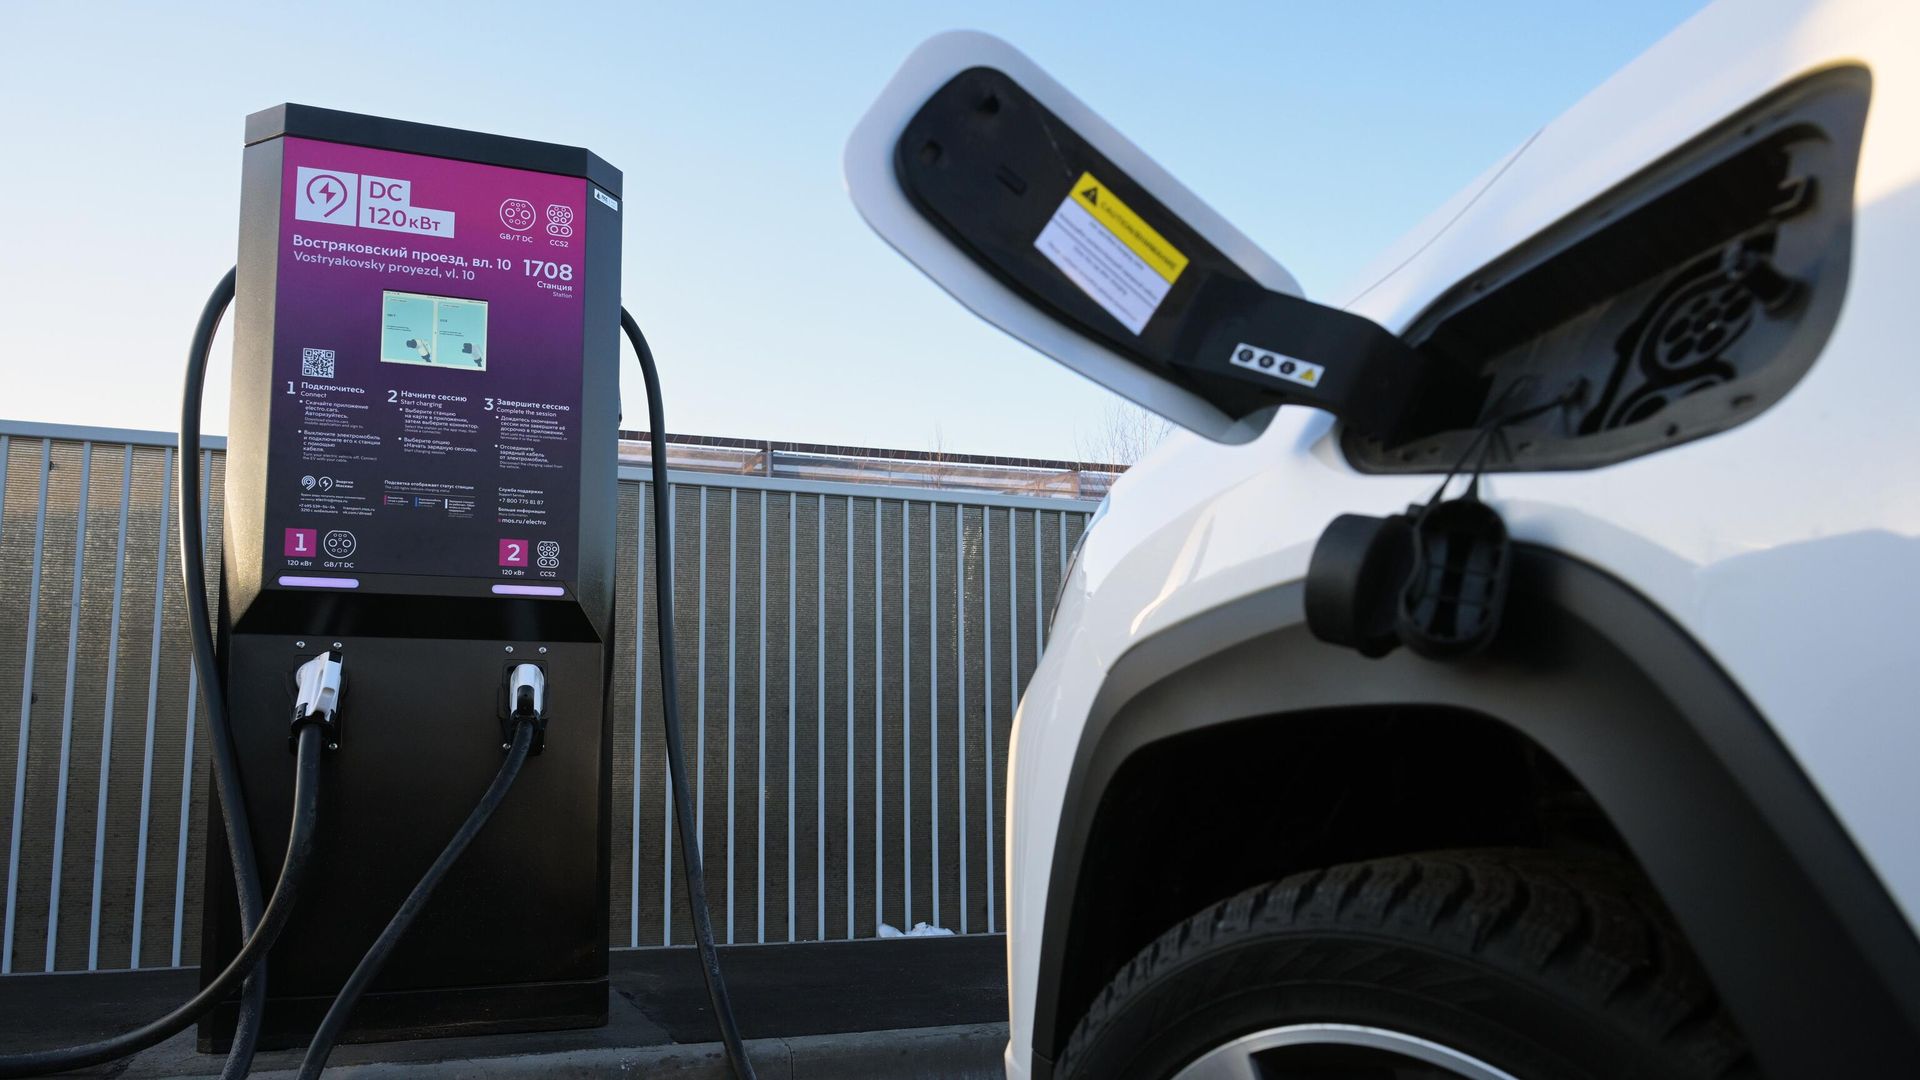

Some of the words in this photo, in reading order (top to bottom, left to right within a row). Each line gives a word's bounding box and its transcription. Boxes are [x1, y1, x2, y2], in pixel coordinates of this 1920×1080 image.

[370, 181, 402, 201] DC
[500, 232, 520, 242] GB/T
[522, 234, 533, 244] DC
[549, 239, 569, 248] CCS2
[293, 234, 407, 261] Востряковский
[412, 246, 468, 267] проезд,
[472, 259, 493, 269] вл.
[496, 259, 511, 271] 10
[294, 251, 386, 274] Vostryakovsky
[388, 261, 442, 280] proyezd,
[445, 267, 459, 279] vl.
[462, 269, 475, 281] 10
[523, 259, 573, 281] 1708
[536, 280, 572, 292] Станция
[552, 290, 572, 300] Station
[287, 381, 296, 394] 1
[301, 382, 365, 394] Подключитесь
[387, 390, 398, 403] 2
[401, 390, 436, 399] Начните
[416, 400, 442, 408] charging
[484, 398, 494, 410] 3
[497, 398, 540, 408] Завершите
[295, 533, 307, 552] 1
[507, 544, 520, 561] 2
